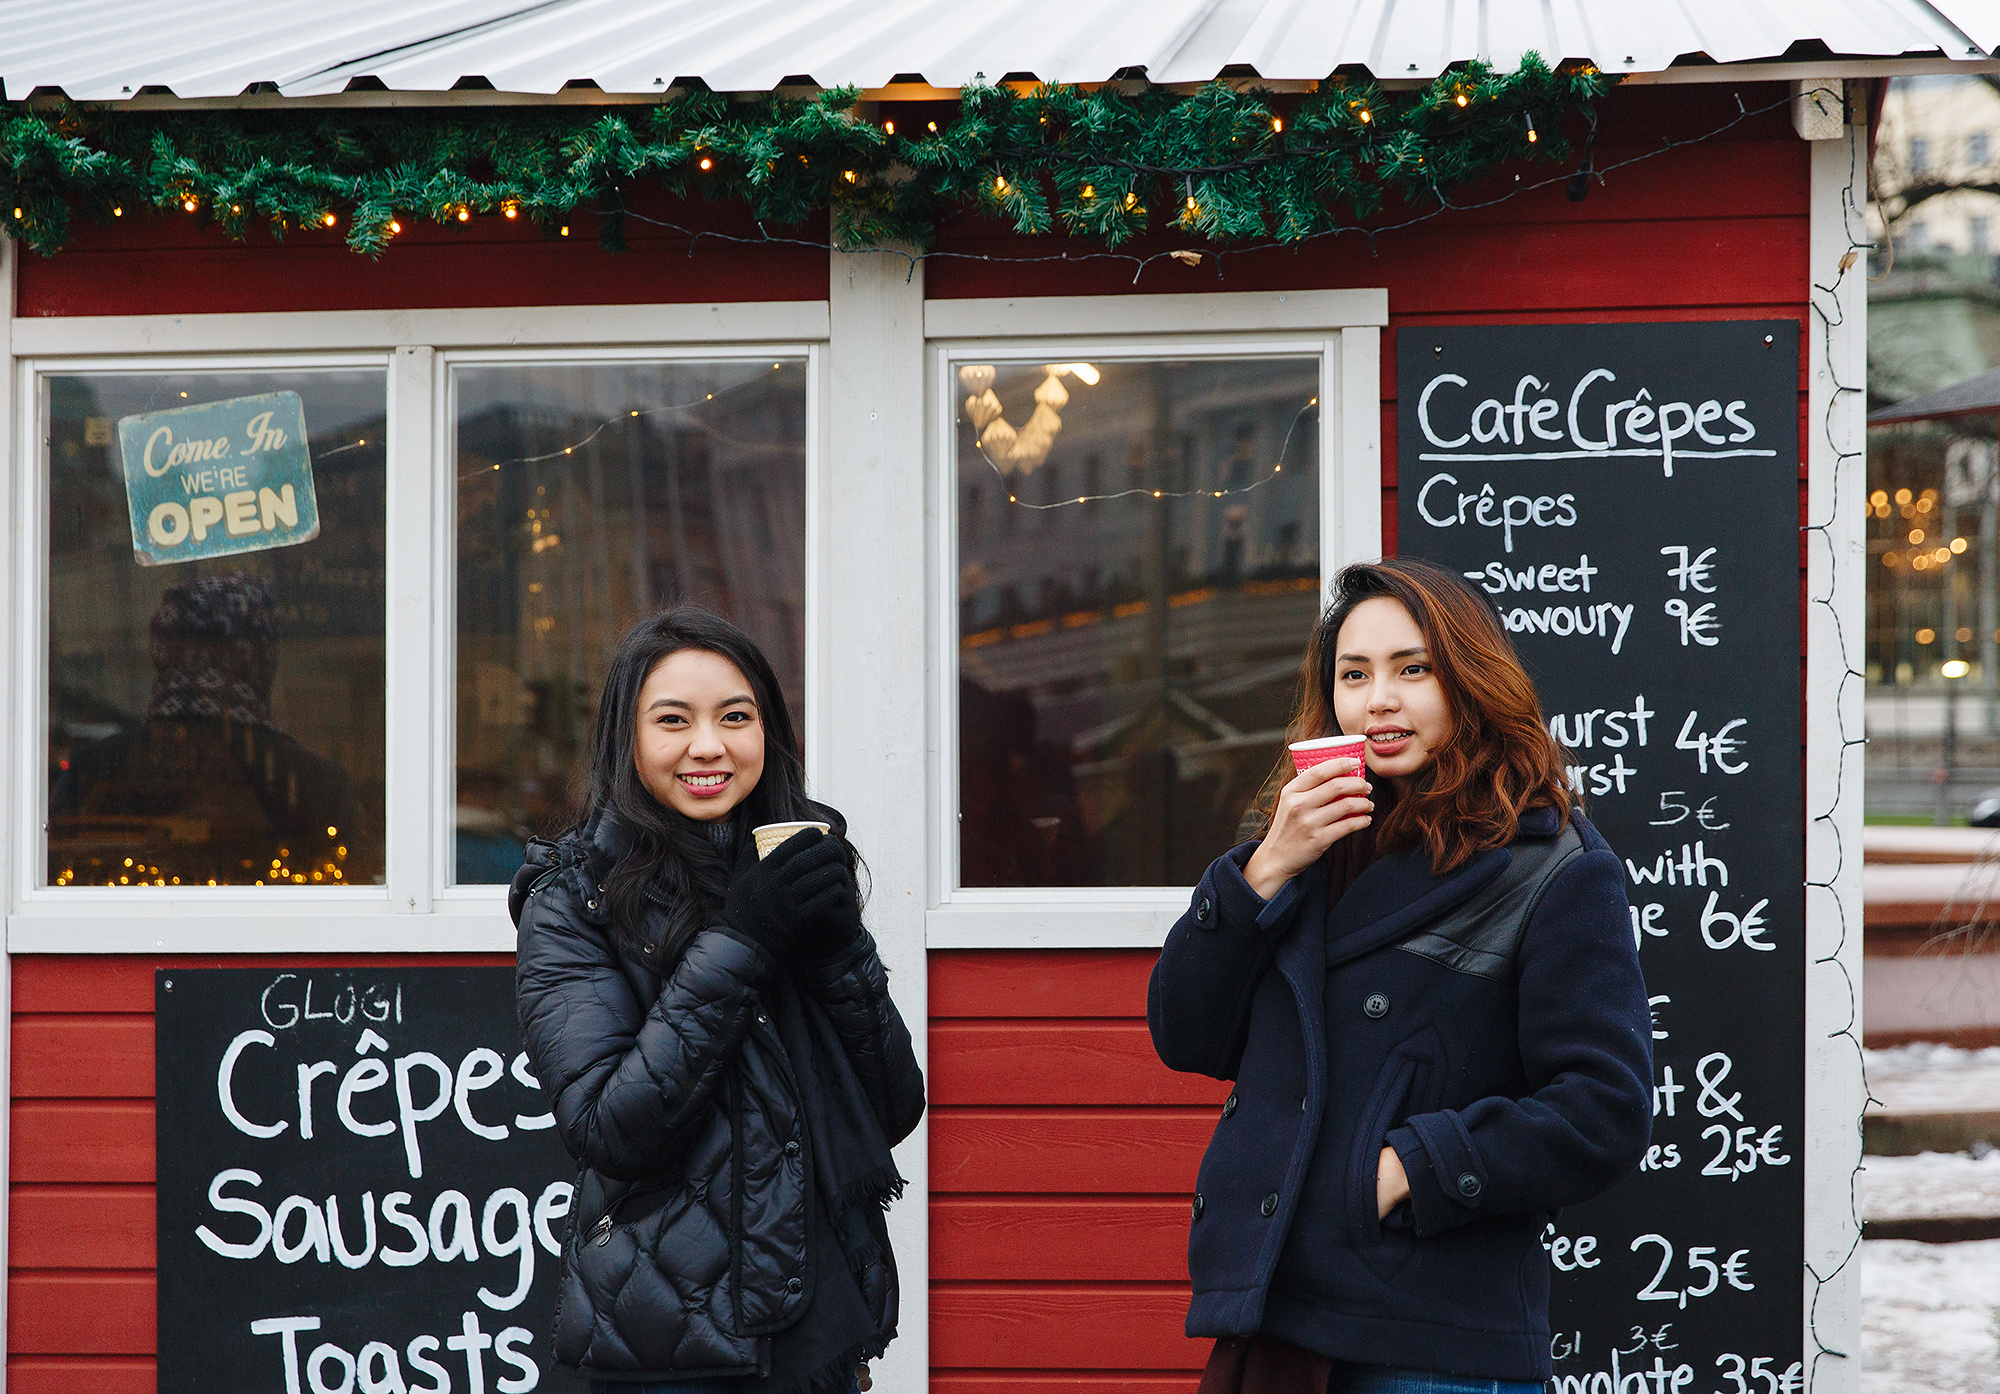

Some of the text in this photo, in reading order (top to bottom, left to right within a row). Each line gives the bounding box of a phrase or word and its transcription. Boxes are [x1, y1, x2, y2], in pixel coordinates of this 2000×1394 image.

[143, 411, 288, 478] Come In
[1417, 368, 1756, 478] Café Crêpes
[180, 465, 249, 495] WE'RE
[1416, 472, 1578, 553] Crêpes
[147, 483, 299, 549] OPEN
[1660, 545, 1719, 594] 7€
[1664, 598, 1723, 647] 9€
[1549, 693, 1750, 774] urst 4€
[1625, 840, 1729, 887] with
[1700, 890, 1777, 951] 6€
[217, 1028, 557, 1179] Crêpes
[1695, 1051, 1745, 1122] &
[1700, 1124, 1792, 1183] 2,5€
[194, 1168, 575, 1312] Sausage
[1630, 1233, 1756, 1310] 2,5€
[250, 1311, 541, 1394] Toasts
